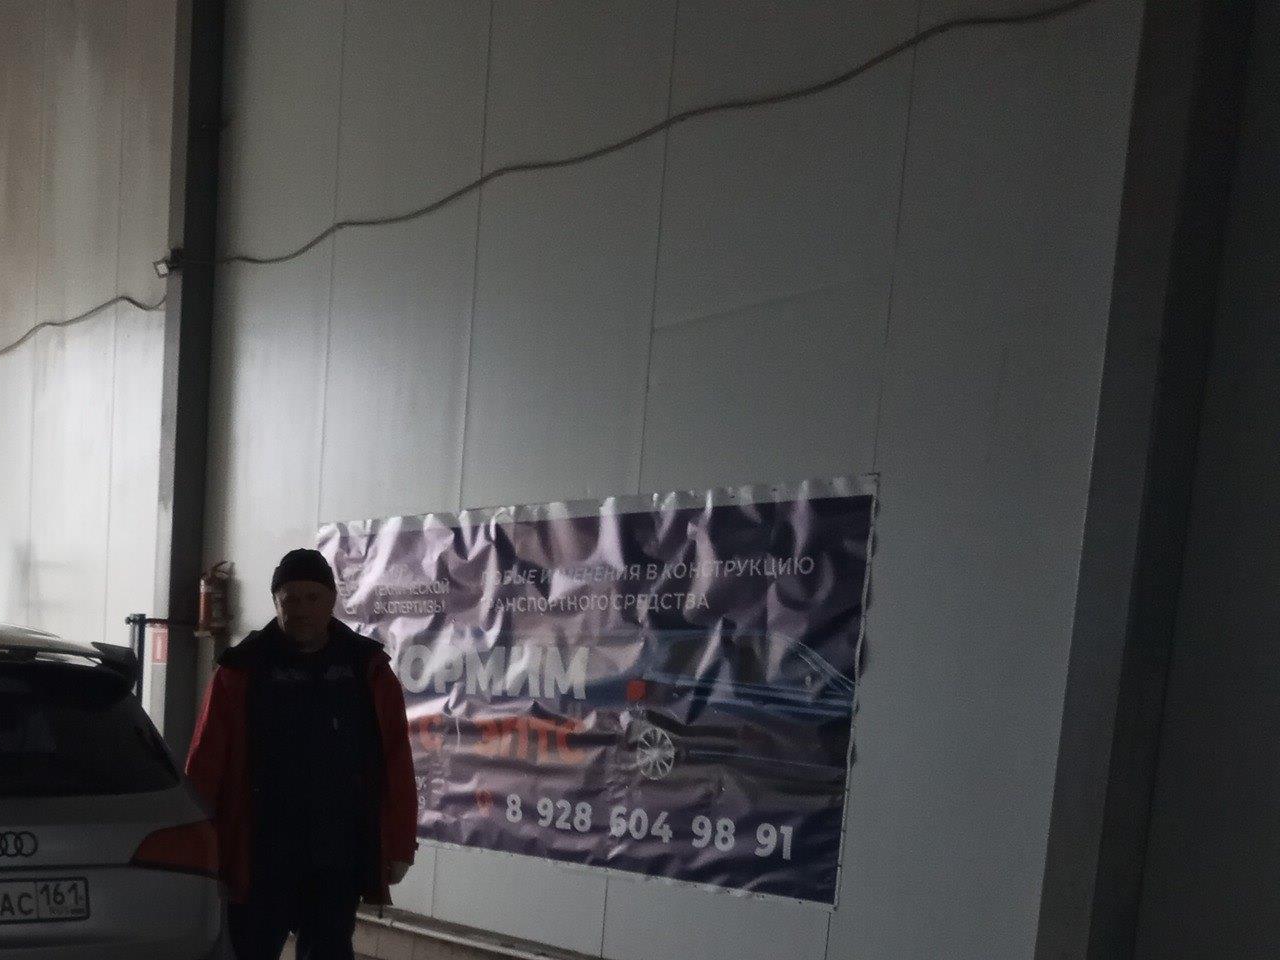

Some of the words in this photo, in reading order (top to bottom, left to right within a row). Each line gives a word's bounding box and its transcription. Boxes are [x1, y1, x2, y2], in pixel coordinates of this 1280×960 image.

[663, 555, 816, 580] КОНТРУКЦИЮ
[505, 793, 522, 823] 8
[536, 797, 592, 833] 928
[608, 804, 673, 843] 604
[691, 815, 737, 852] 98
[753, 823, 793, 860] 91
[40, 883, 80, 905] 161
